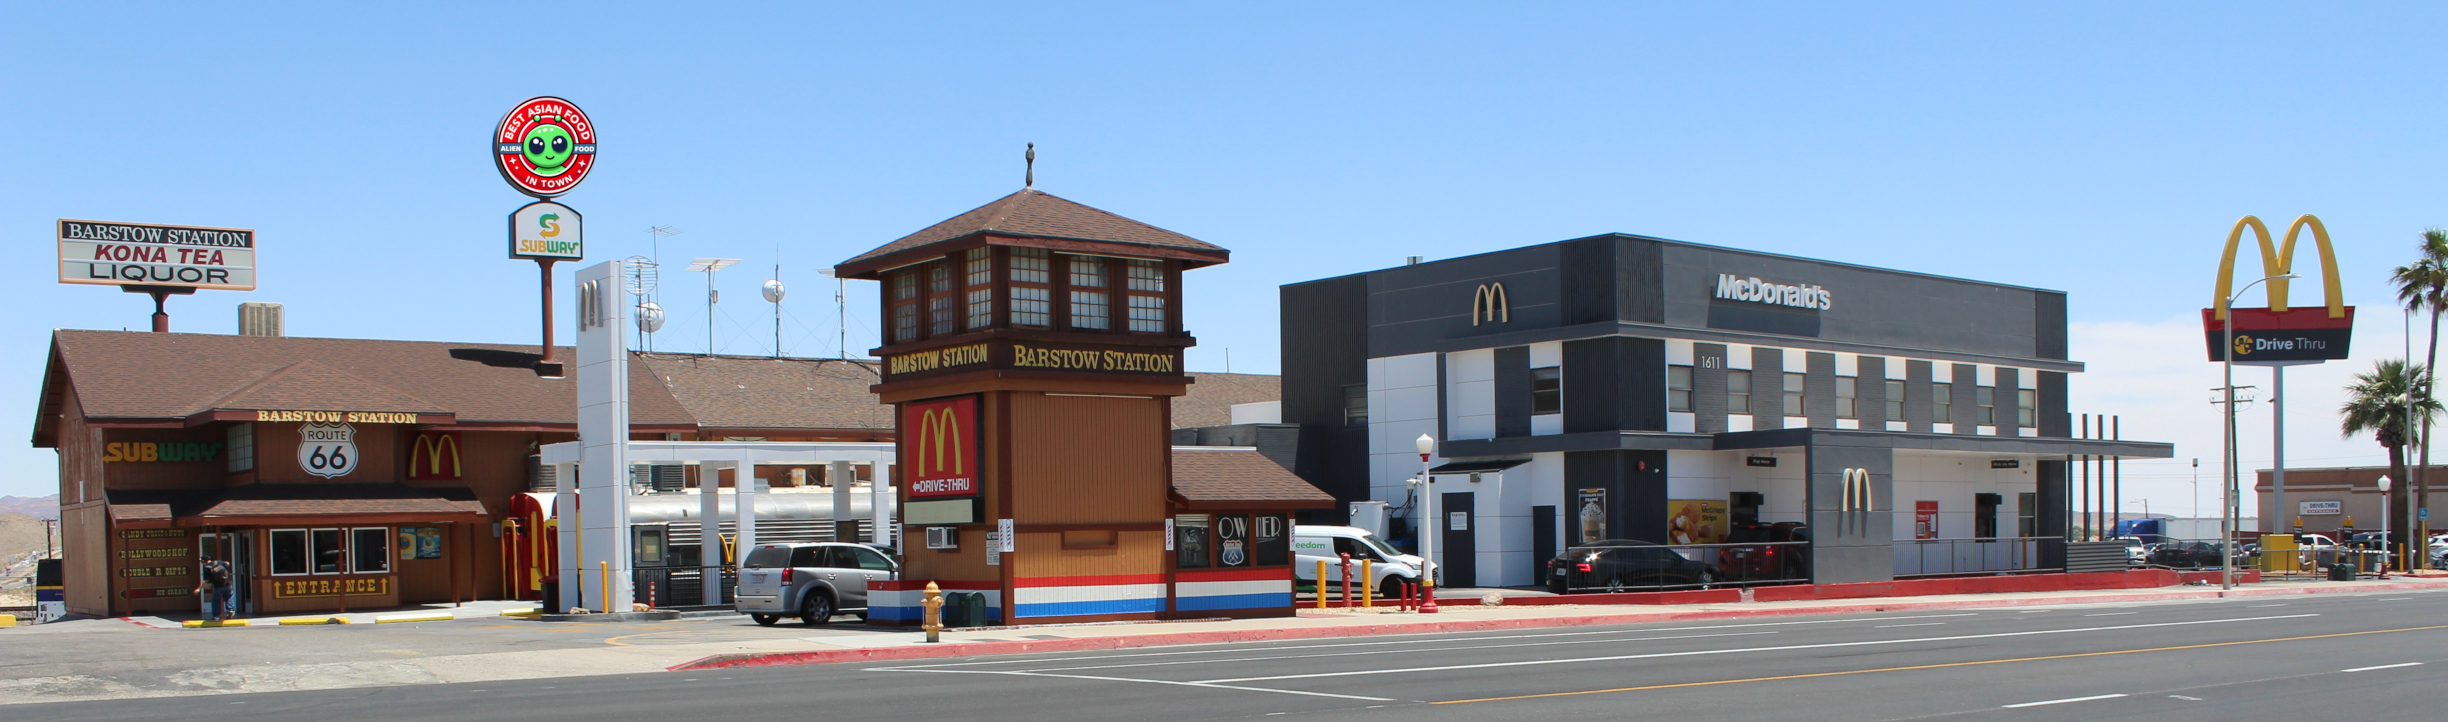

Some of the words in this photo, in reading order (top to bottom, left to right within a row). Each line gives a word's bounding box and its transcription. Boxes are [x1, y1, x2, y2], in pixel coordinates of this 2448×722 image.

[504, 114, 526, 140] BEST
[527, 104, 562, 118] ASIAN
[563, 109, 590, 141] FOOD
[525, 175, 537, 186] IN
[540, 174, 573, 189] TOWN
[68, 223, 164, 243] BARSTOW
[168, 228, 247, 248] STATION
[94, 244, 168, 263] KONA
[177, 248, 225, 266] TEA
[519, 239, 580, 255] SUBWAY
[89, 263, 230, 284] LIQUOR
[1716, 272, 1832, 312] McDonald's
[2255, 337, 2294, 351] Drive
[2296, 337, 2326, 350] Thru
[890, 349, 940, 375] BARSTOW
[942, 343, 988, 368] STATION
[1013, 344, 1101, 370] BARSTOW
[1103, 349, 1174, 373] STATION
[1700, 354, 1721, 370] 1611
[257, 410, 342, 423] BARSTOW
[348, 411, 418, 424] STATION
[307, 430, 347, 441] ROUTE
[103, 441, 224, 464] SUBWAY
[308, 445, 348, 470] 66
[919, 477, 970, 493] DRIVE-THRU
[1701, 507, 1725, 515] McCrispy
[121, 530, 145, 539] CANDY
[1295, 541, 1325, 549] eedom
[165, 567, 187, 576] GIFTS
[285, 578, 376, 595] ENTRANCE
